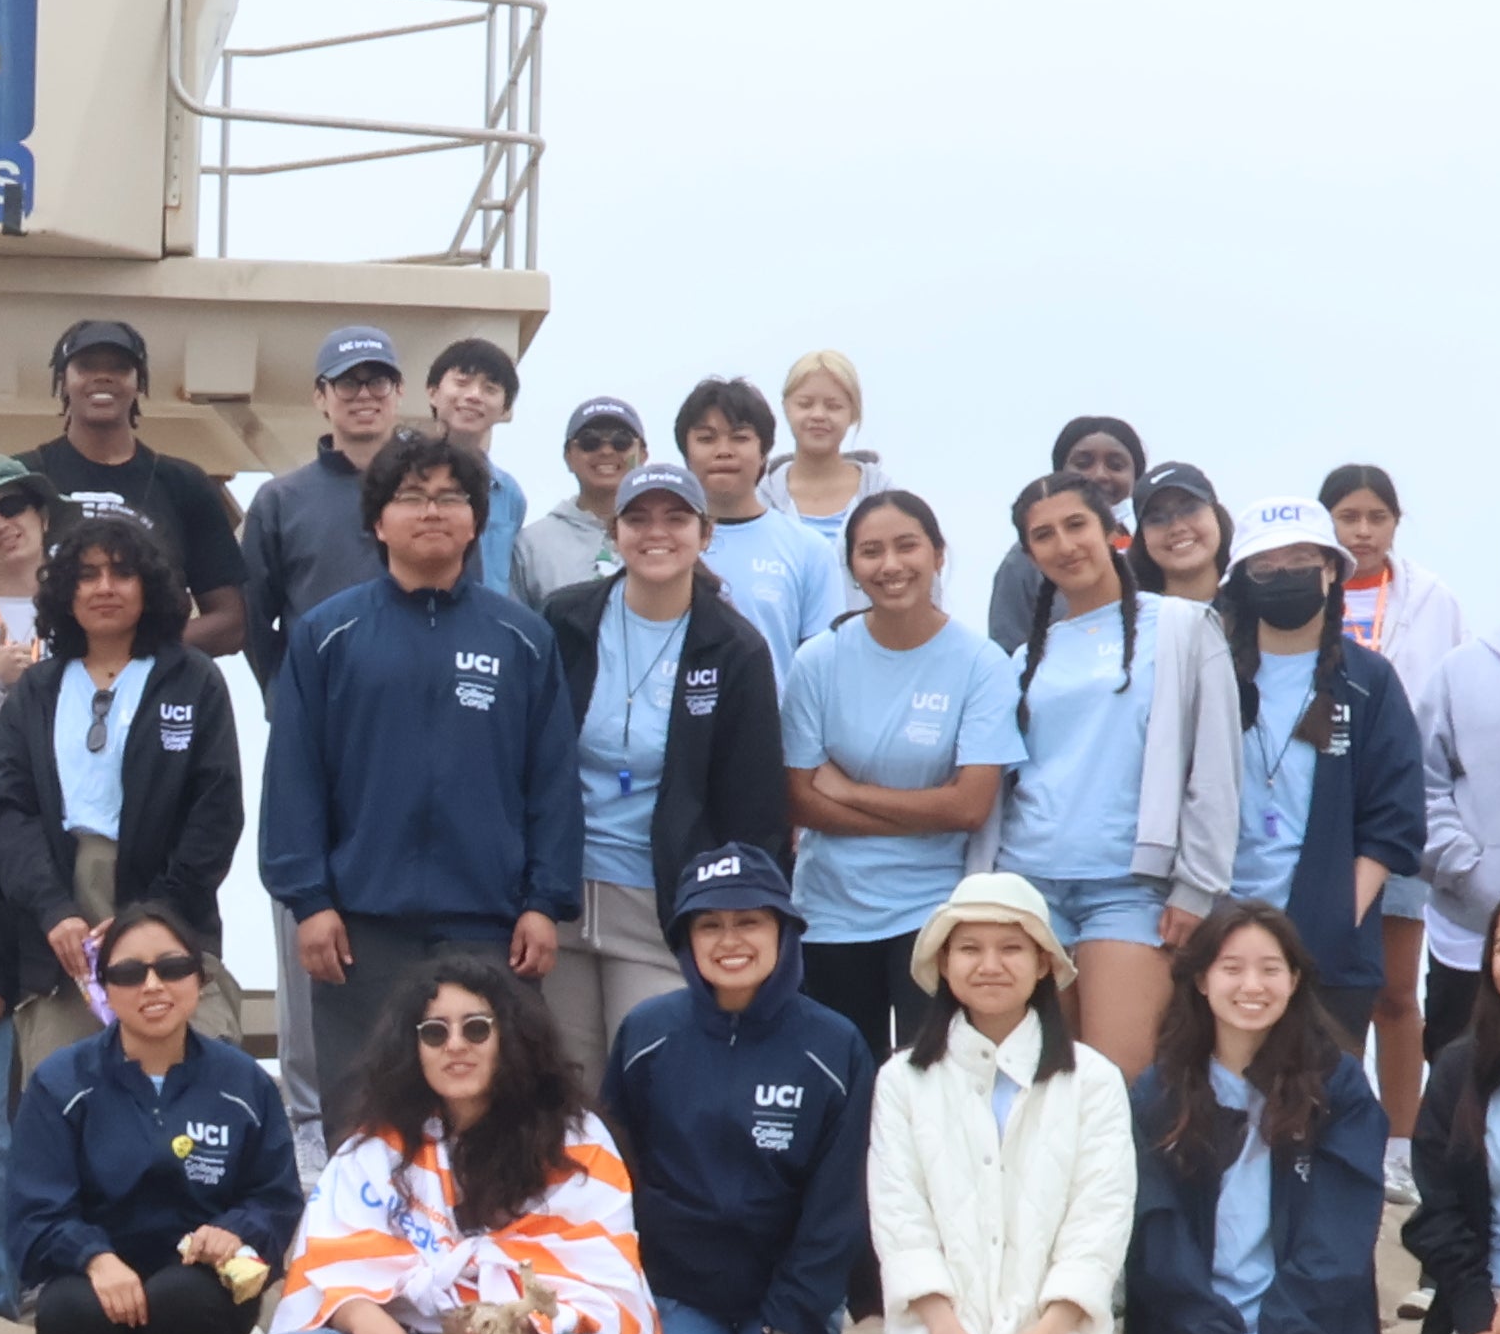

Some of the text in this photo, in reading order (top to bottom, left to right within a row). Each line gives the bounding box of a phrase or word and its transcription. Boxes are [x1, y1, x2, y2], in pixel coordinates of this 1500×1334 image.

[1261, 506, 1301, 525] UCI
[751, 558, 787, 576] UCI
[455, 651, 500, 677] UCI
[685, 667, 719, 686] UCI
[160, 702, 194, 722] UCI
[911, 691, 950, 712] UCI
[697, 856, 742, 882] UCI
[754, 1084, 804, 1109] UCI
[186, 1120, 230, 1147] UCI
